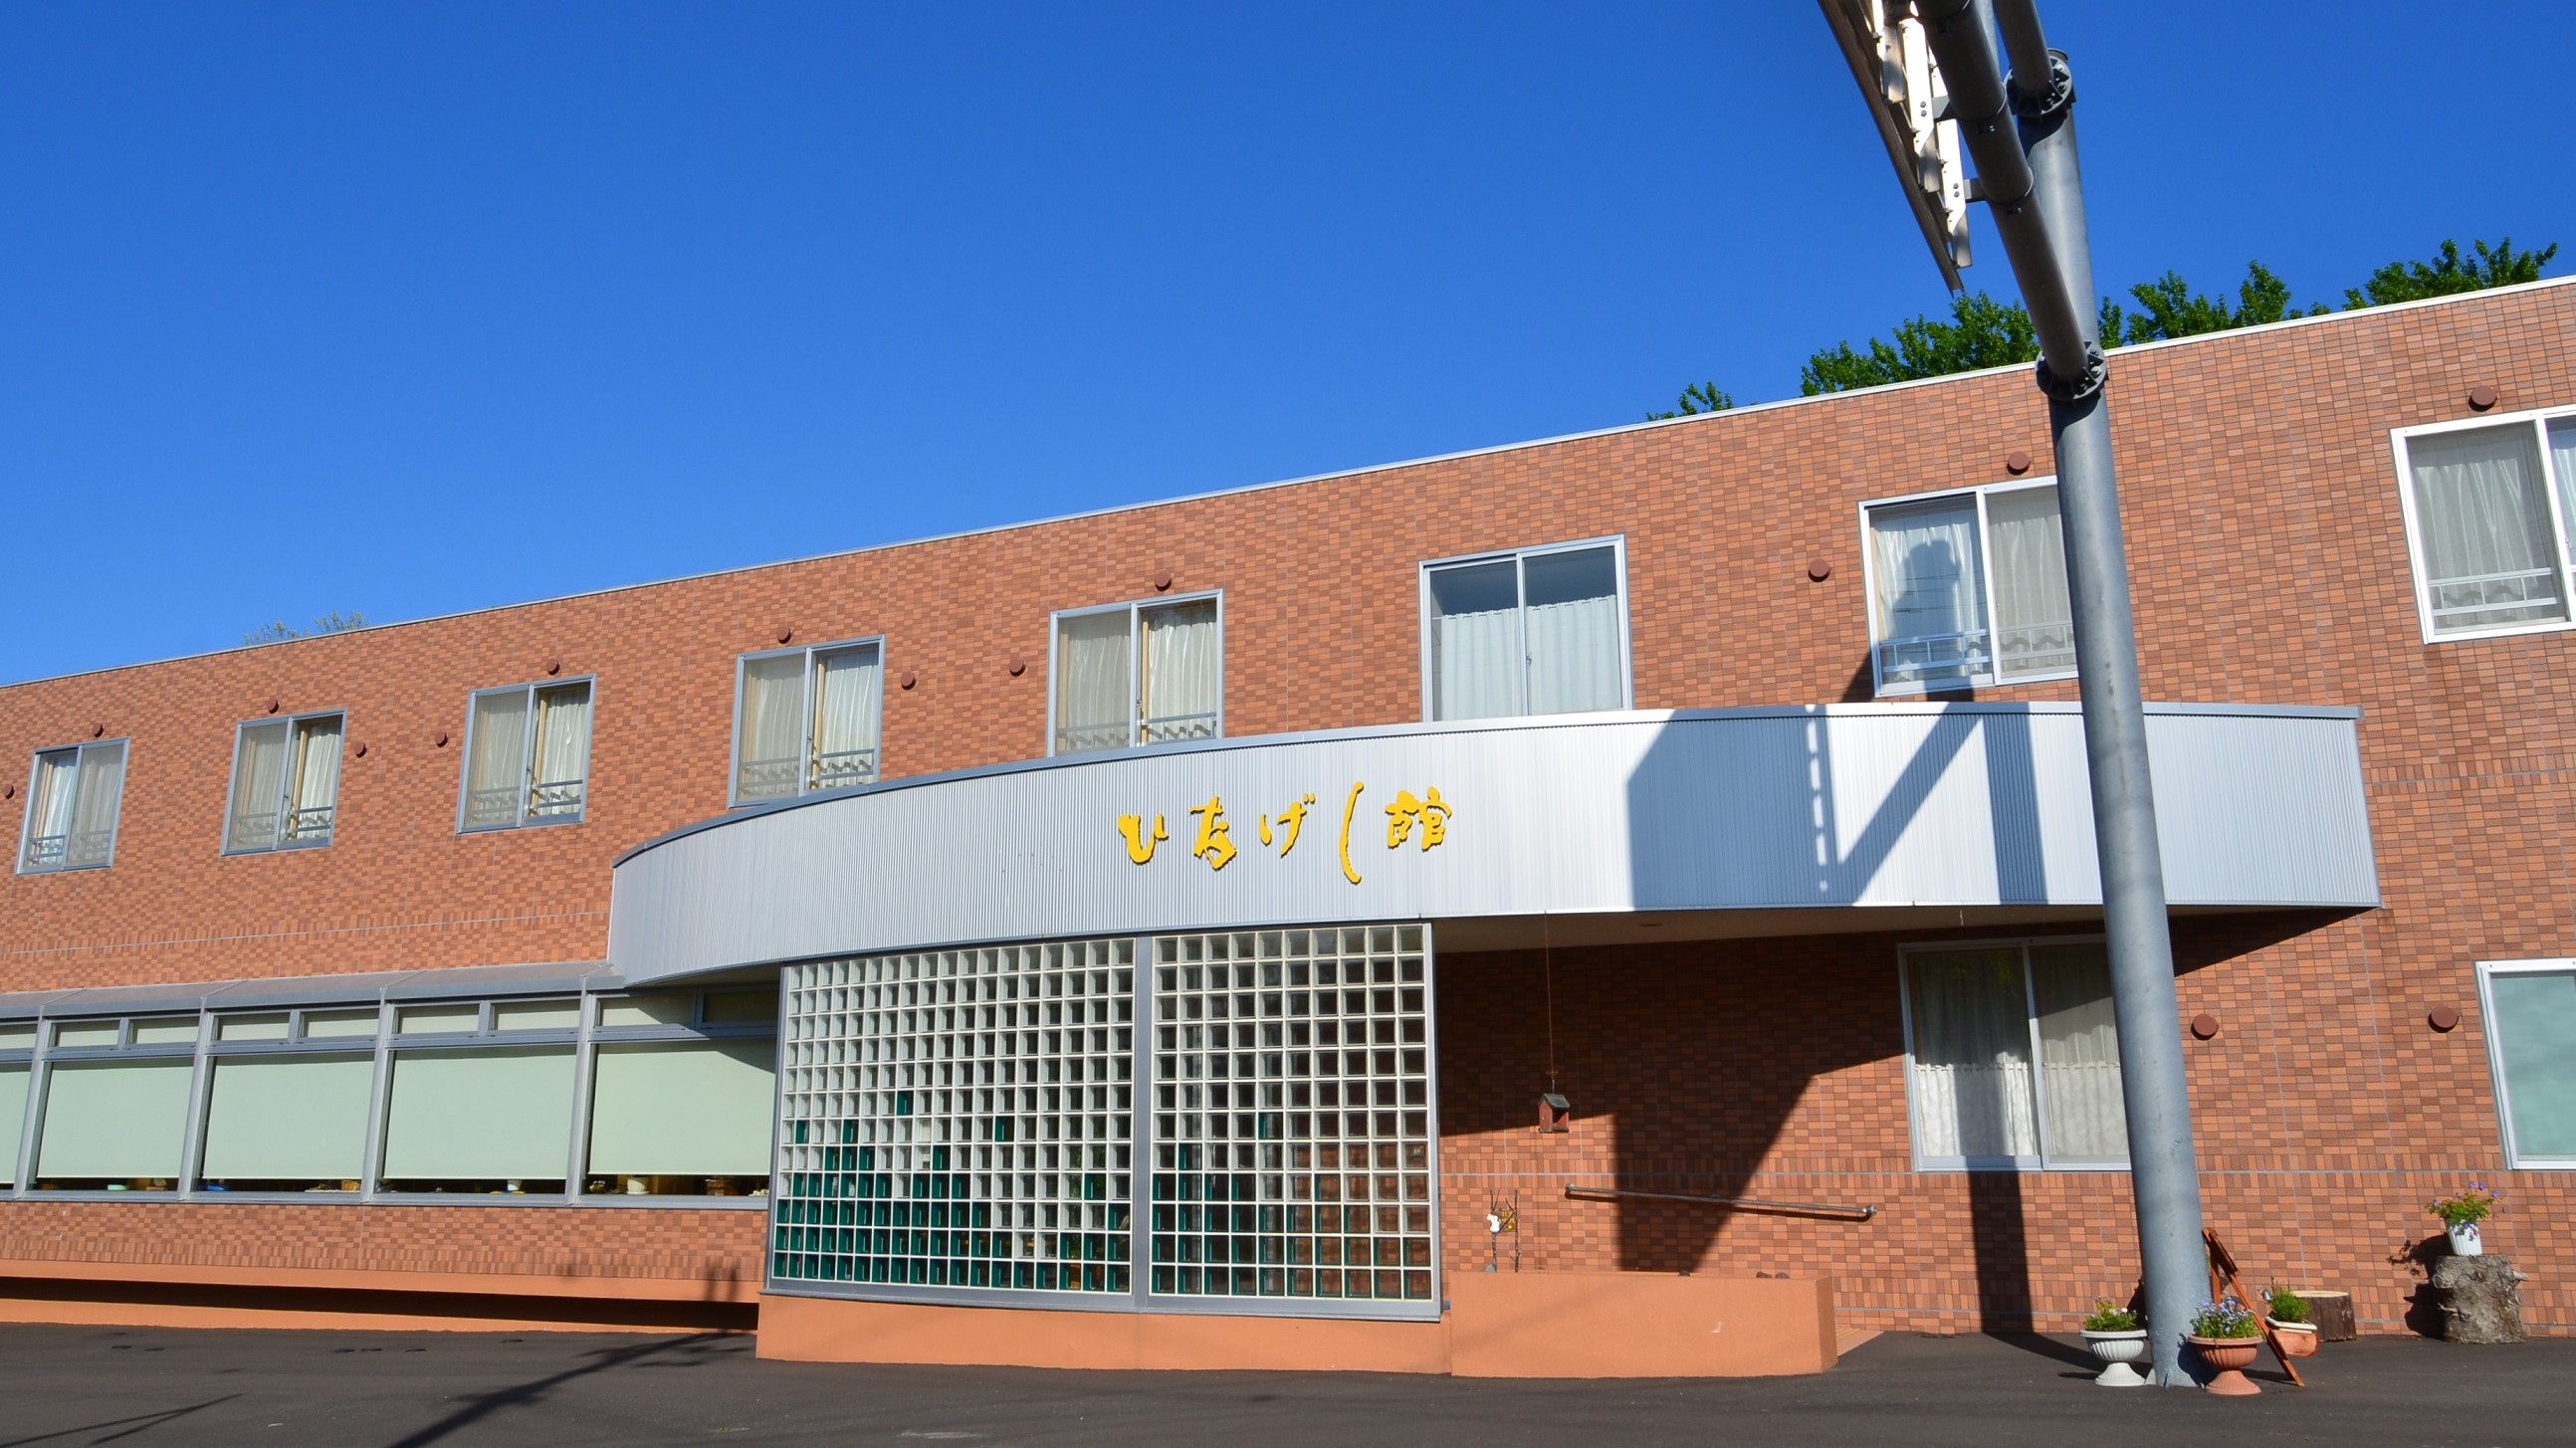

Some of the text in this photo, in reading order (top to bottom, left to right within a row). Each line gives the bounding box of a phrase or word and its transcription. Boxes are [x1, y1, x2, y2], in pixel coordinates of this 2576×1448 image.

[1118, 781, 1452, 884] ひなげし館
